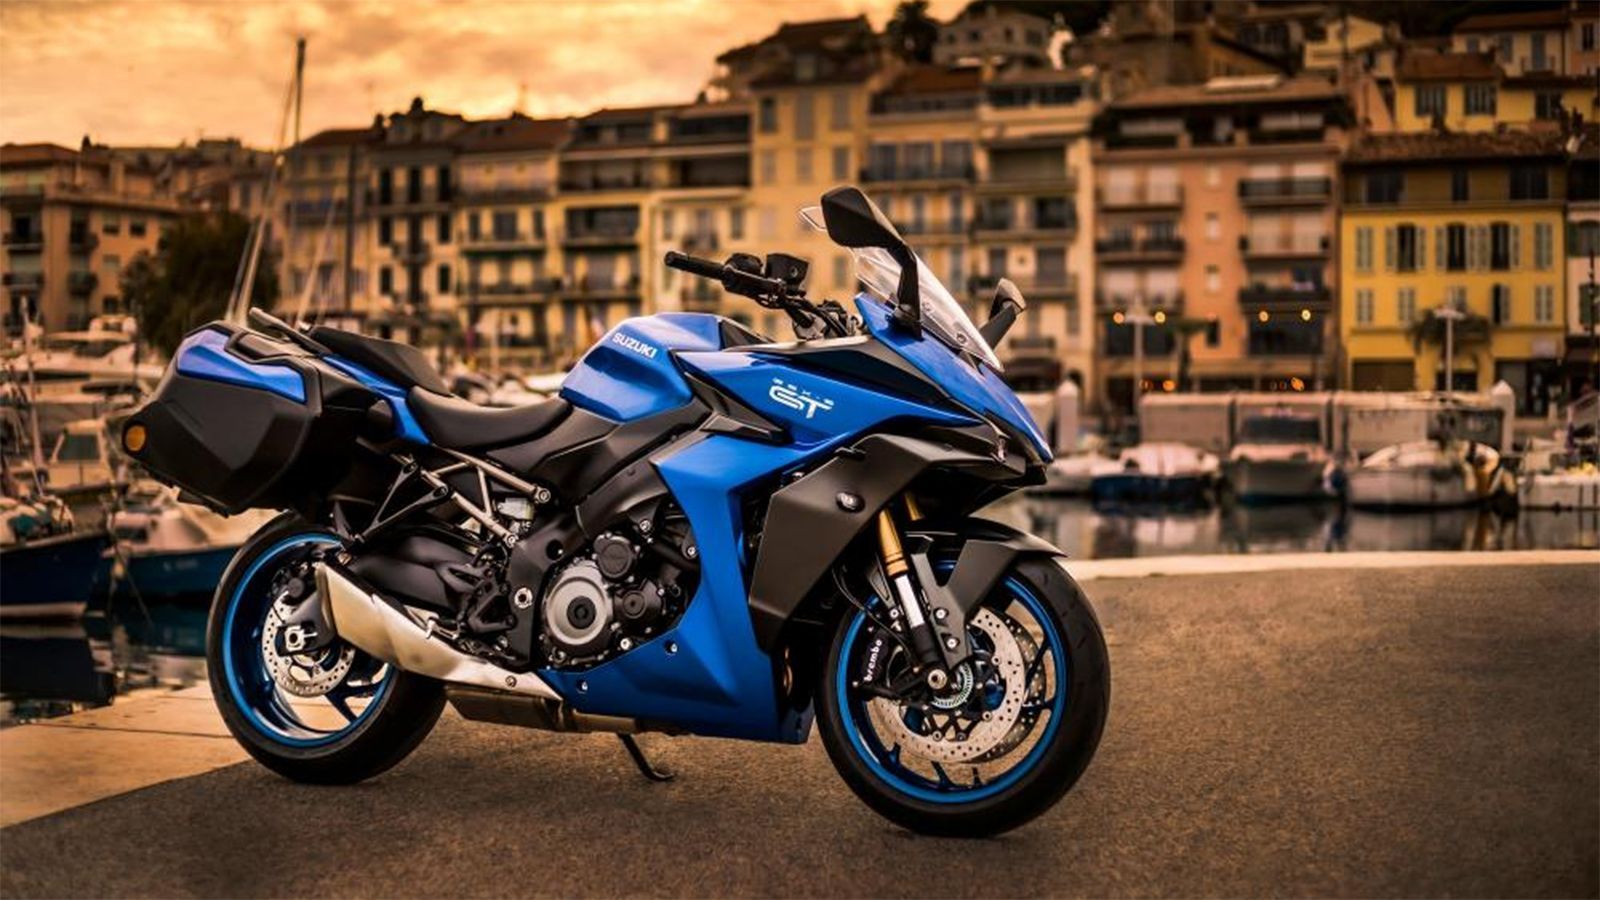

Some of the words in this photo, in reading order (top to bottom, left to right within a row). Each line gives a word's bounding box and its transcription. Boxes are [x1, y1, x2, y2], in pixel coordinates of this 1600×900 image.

[612, 332, 658, 359] SUZUKI
[769, 385, 833, 419] GT
[863, 639, 883, 682] brembo
